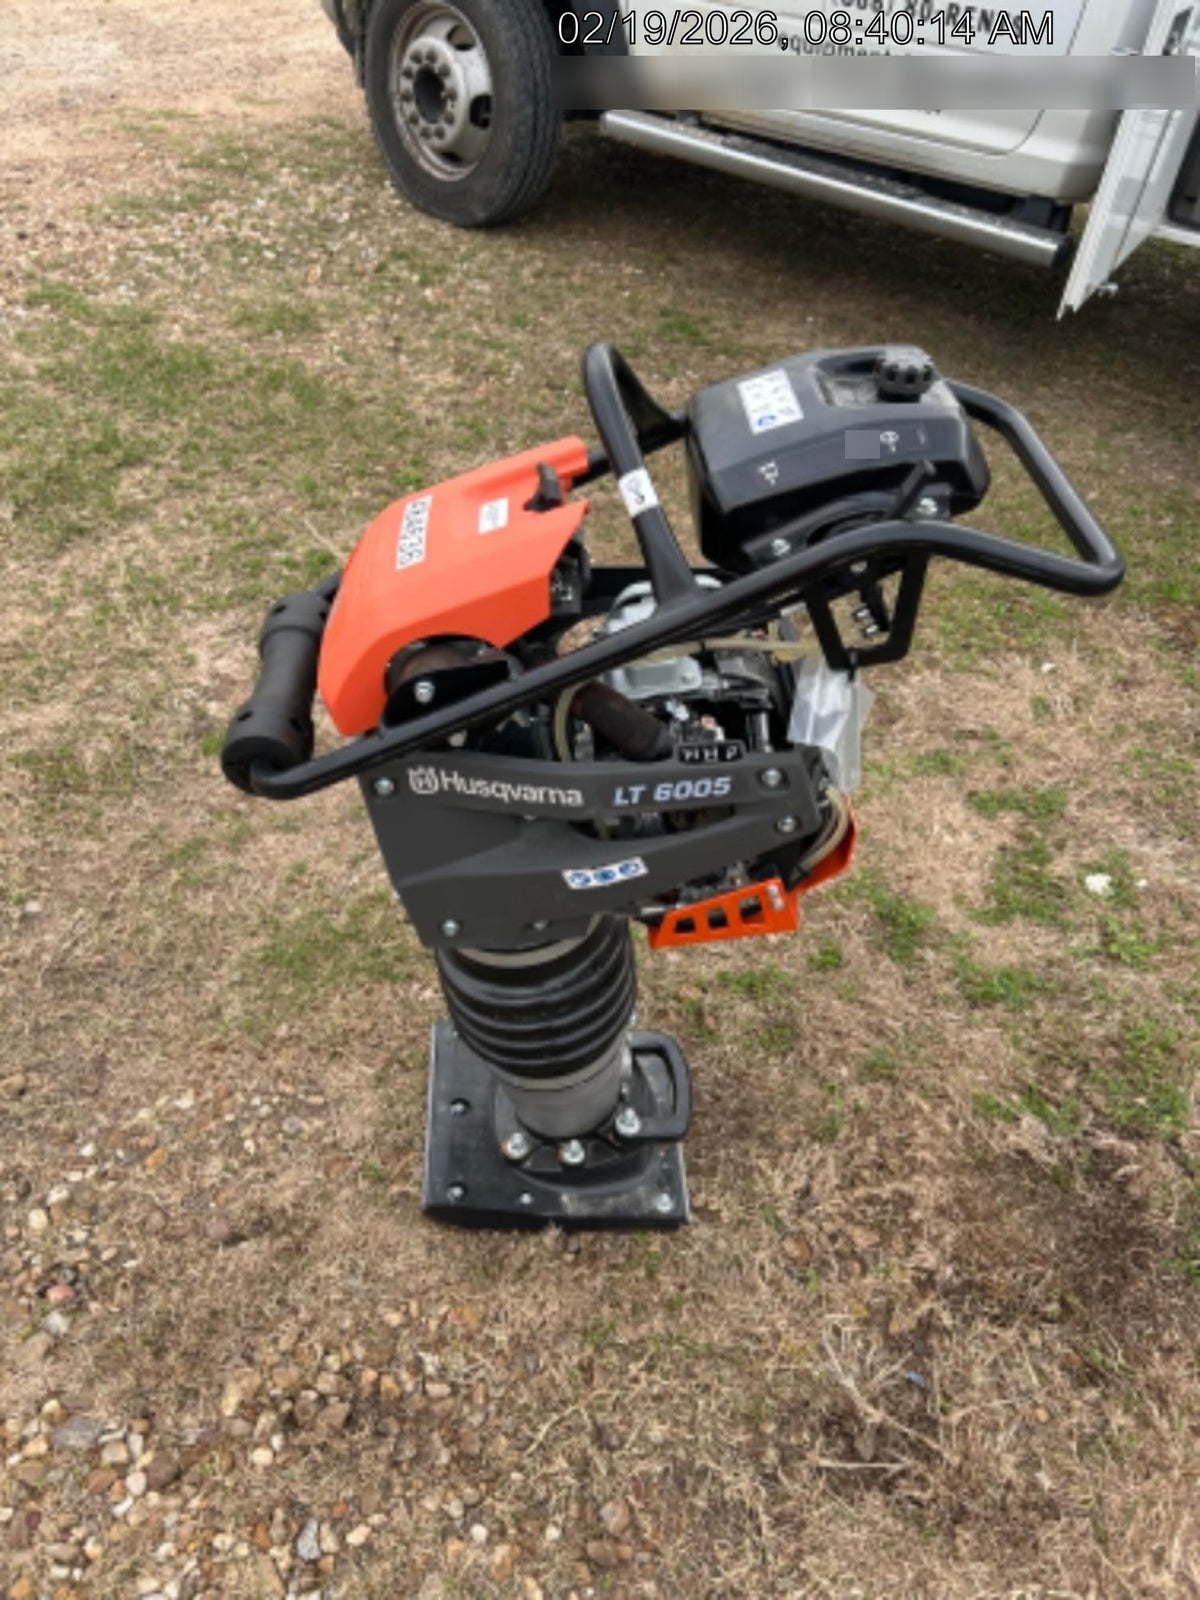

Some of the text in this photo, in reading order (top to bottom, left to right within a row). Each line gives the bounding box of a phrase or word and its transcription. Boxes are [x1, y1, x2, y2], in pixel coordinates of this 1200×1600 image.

[903, 0, 1025, 40] 80-RENS
[440, 769, 583, 807] Husqvarna
[613, 777, 731, 806] LT 6005
